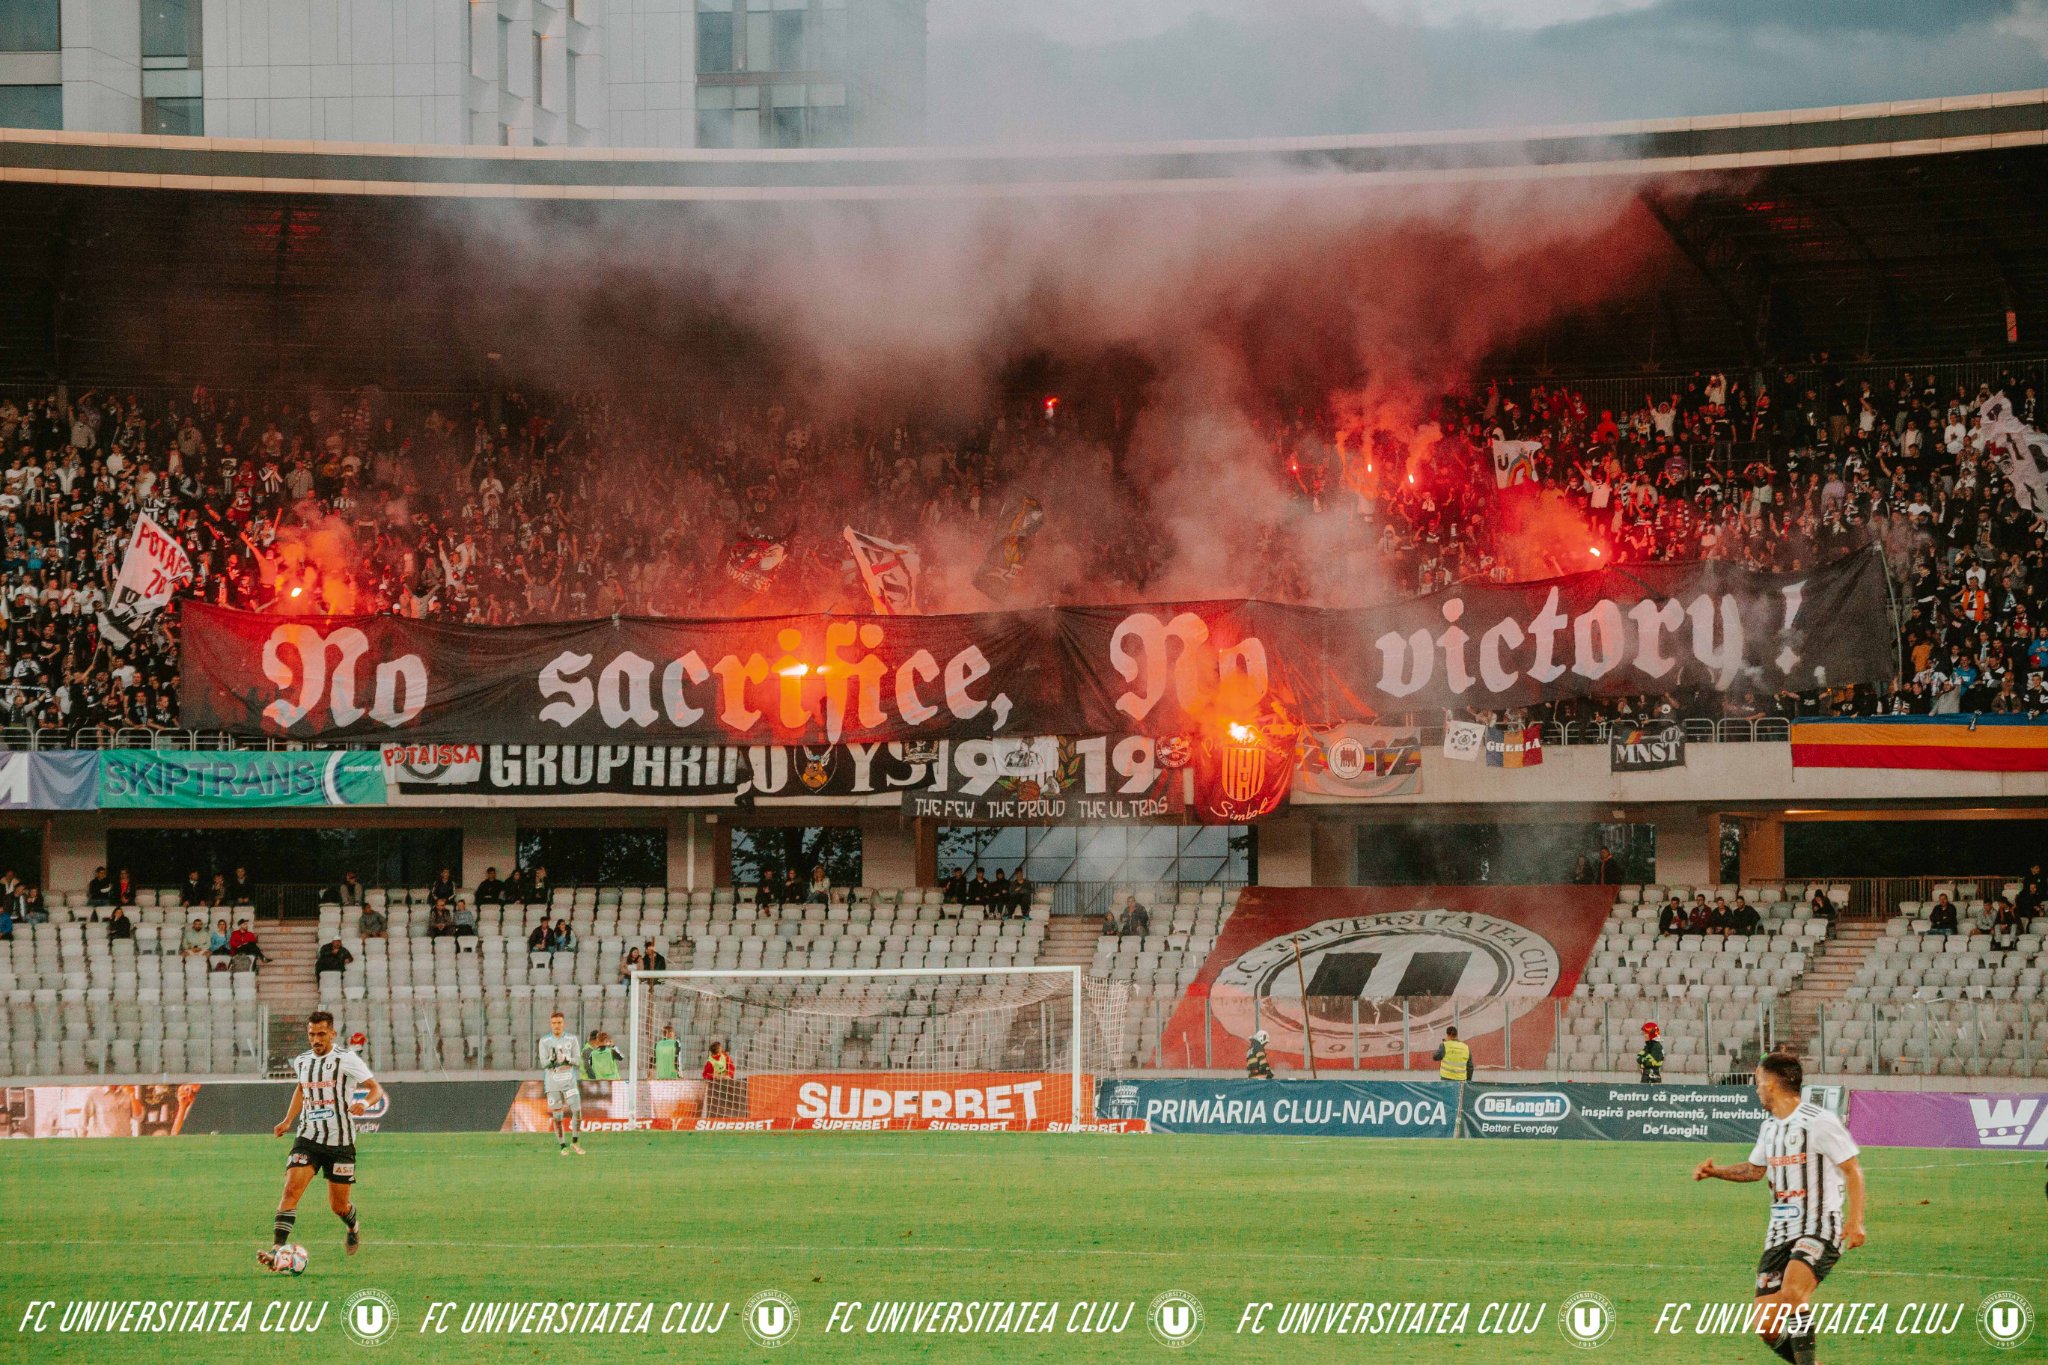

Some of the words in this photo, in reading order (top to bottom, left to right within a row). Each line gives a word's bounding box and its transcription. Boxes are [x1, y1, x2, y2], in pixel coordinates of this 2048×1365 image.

[262, 623, 428, 728] No
[538, 620, 1013, 744] sacrifice,
[1110, 612, 1268, 721] No
[383, 744, 481, 766] POTAISSA
[1616, 741, 1680, 763] MNST
[104, 760, 317, 797] SKIPTRANS
[915, 799, 941, 816] THE
[944, 800, 975, 818] FEW
[987, 801, 1014, 818] THE
[1018, 799, 1065, 818] PROUD
[1079, 801, 1106, 818] THE
[1110, 796, 1168, 818] ULTRAS
[1517, 948, 1549, 987] CLUJ
[1609, 1091, 1649, 1102] Pentru
[1652, 1091, 1666, 1102] că
[1146, 1094, 1267, 1124] PRIMĂRIA
[1273, 1098, 1447, 1125] CLUJ-NAPOCA
[1581, 1106, 1623, 1119] inspiră
[812, 1117, 891, 1130] SUPERBET
[1482, 1123, 1511, 1133] Better
[1513, 1123, 1558, 1136] Everyday
